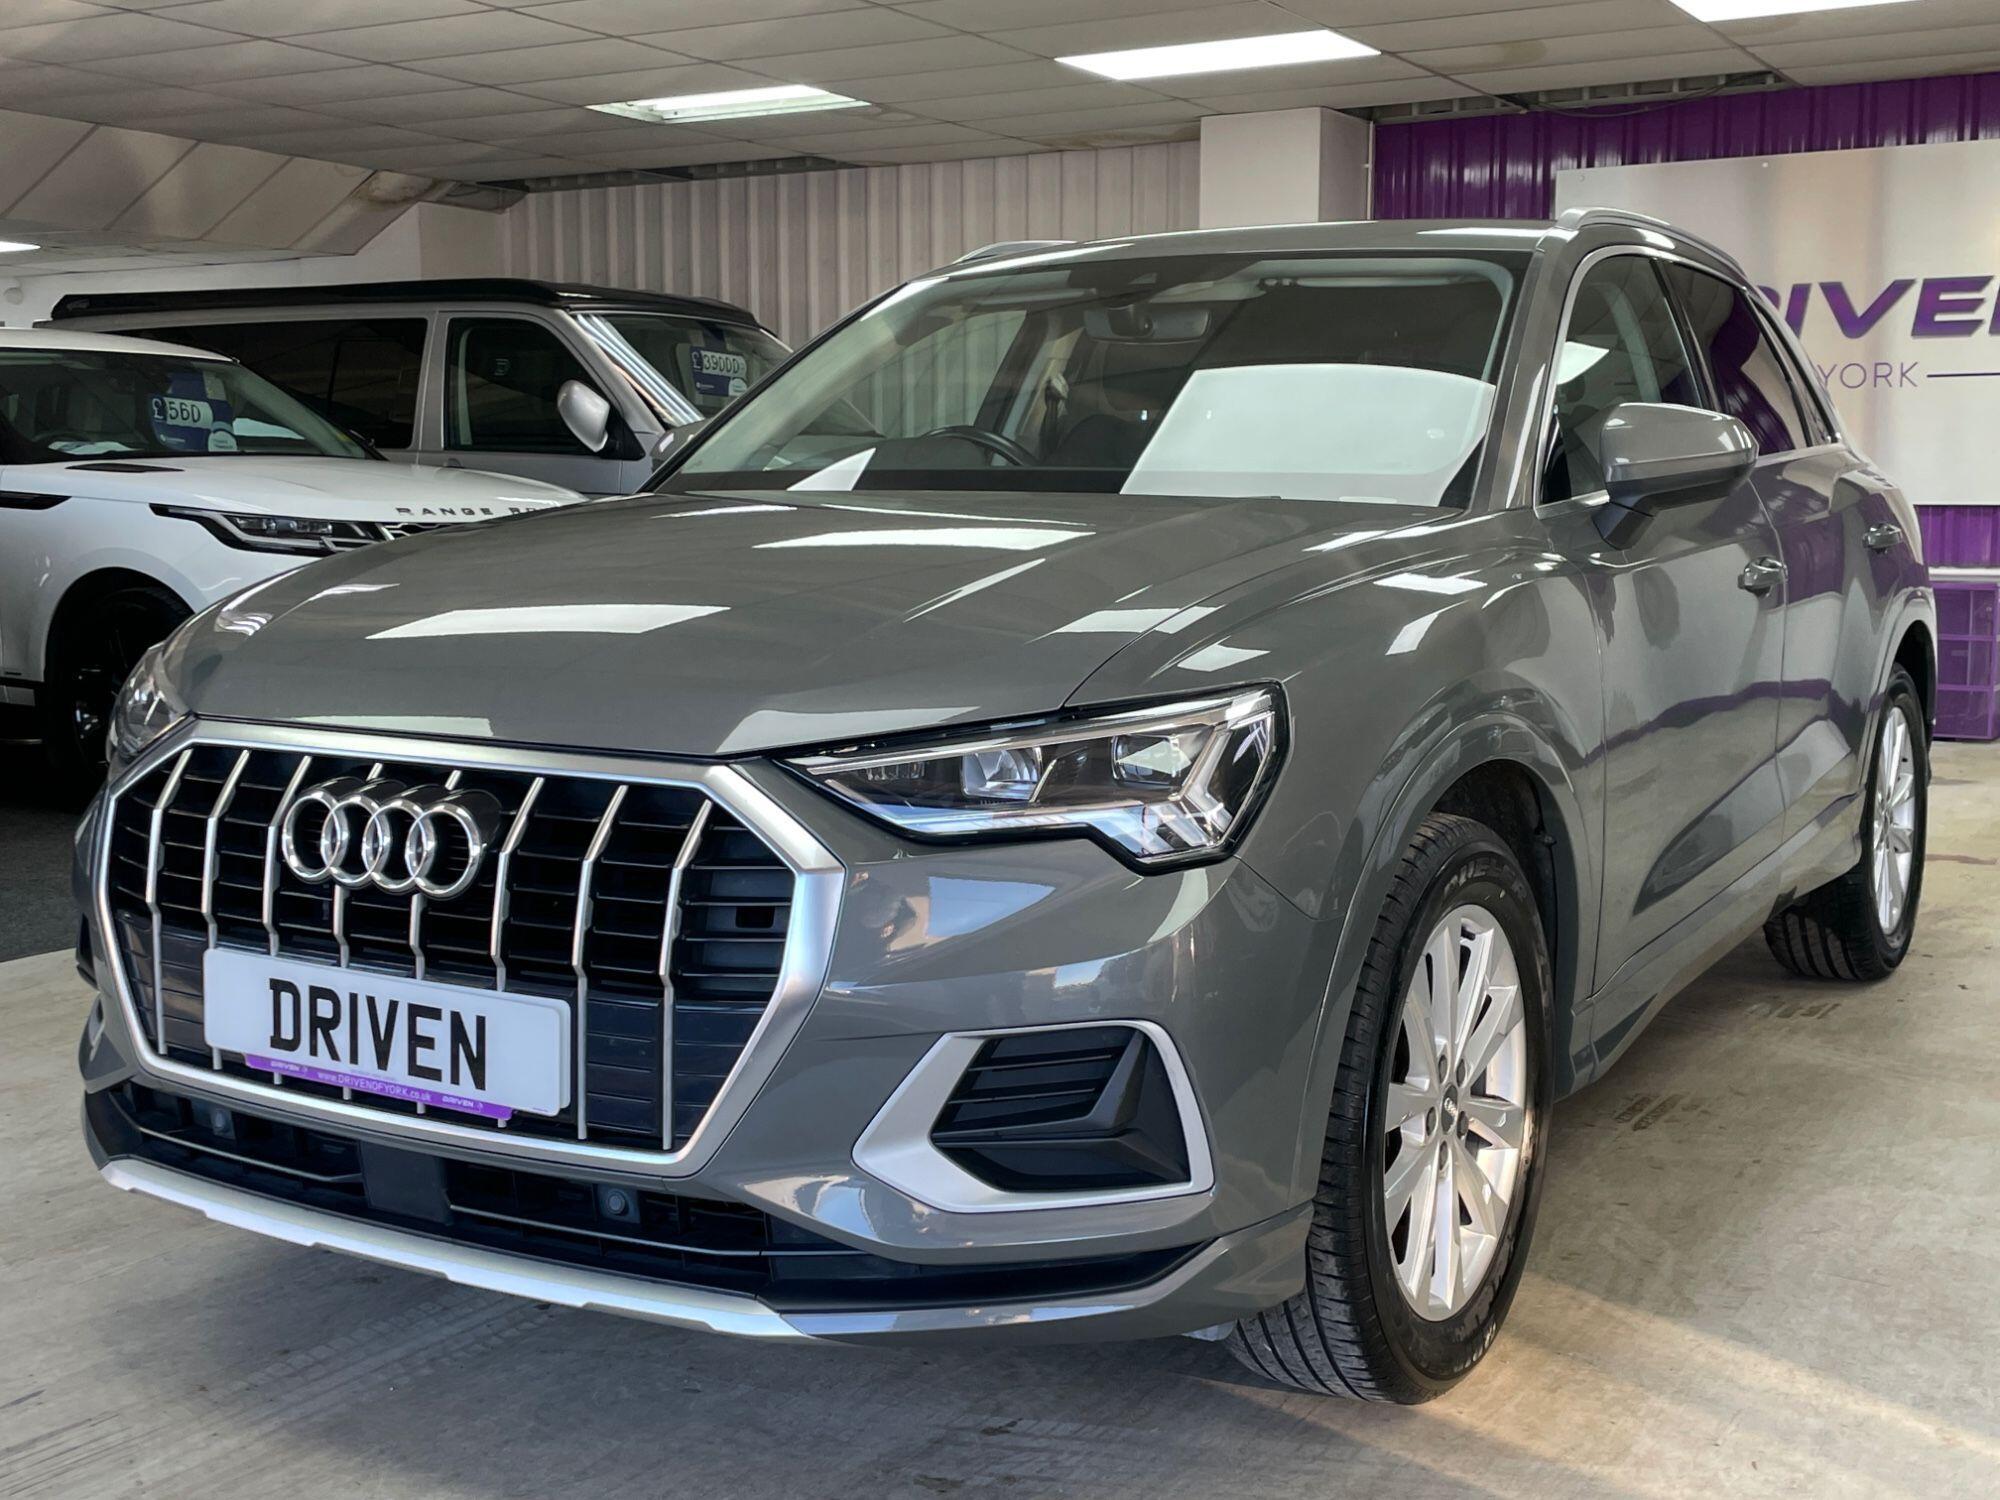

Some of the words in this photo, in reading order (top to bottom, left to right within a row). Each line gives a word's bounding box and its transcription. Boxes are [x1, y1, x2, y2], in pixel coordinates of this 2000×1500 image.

[1758, 275, 2000, 339] IVE
[1817, 362, 1919, 389] YORK
[396, 507, 493, 515] RANGE
[269, 978, 486, 1091] DRIVEN
[441, 1095, 475, 1108] DRIVEN
